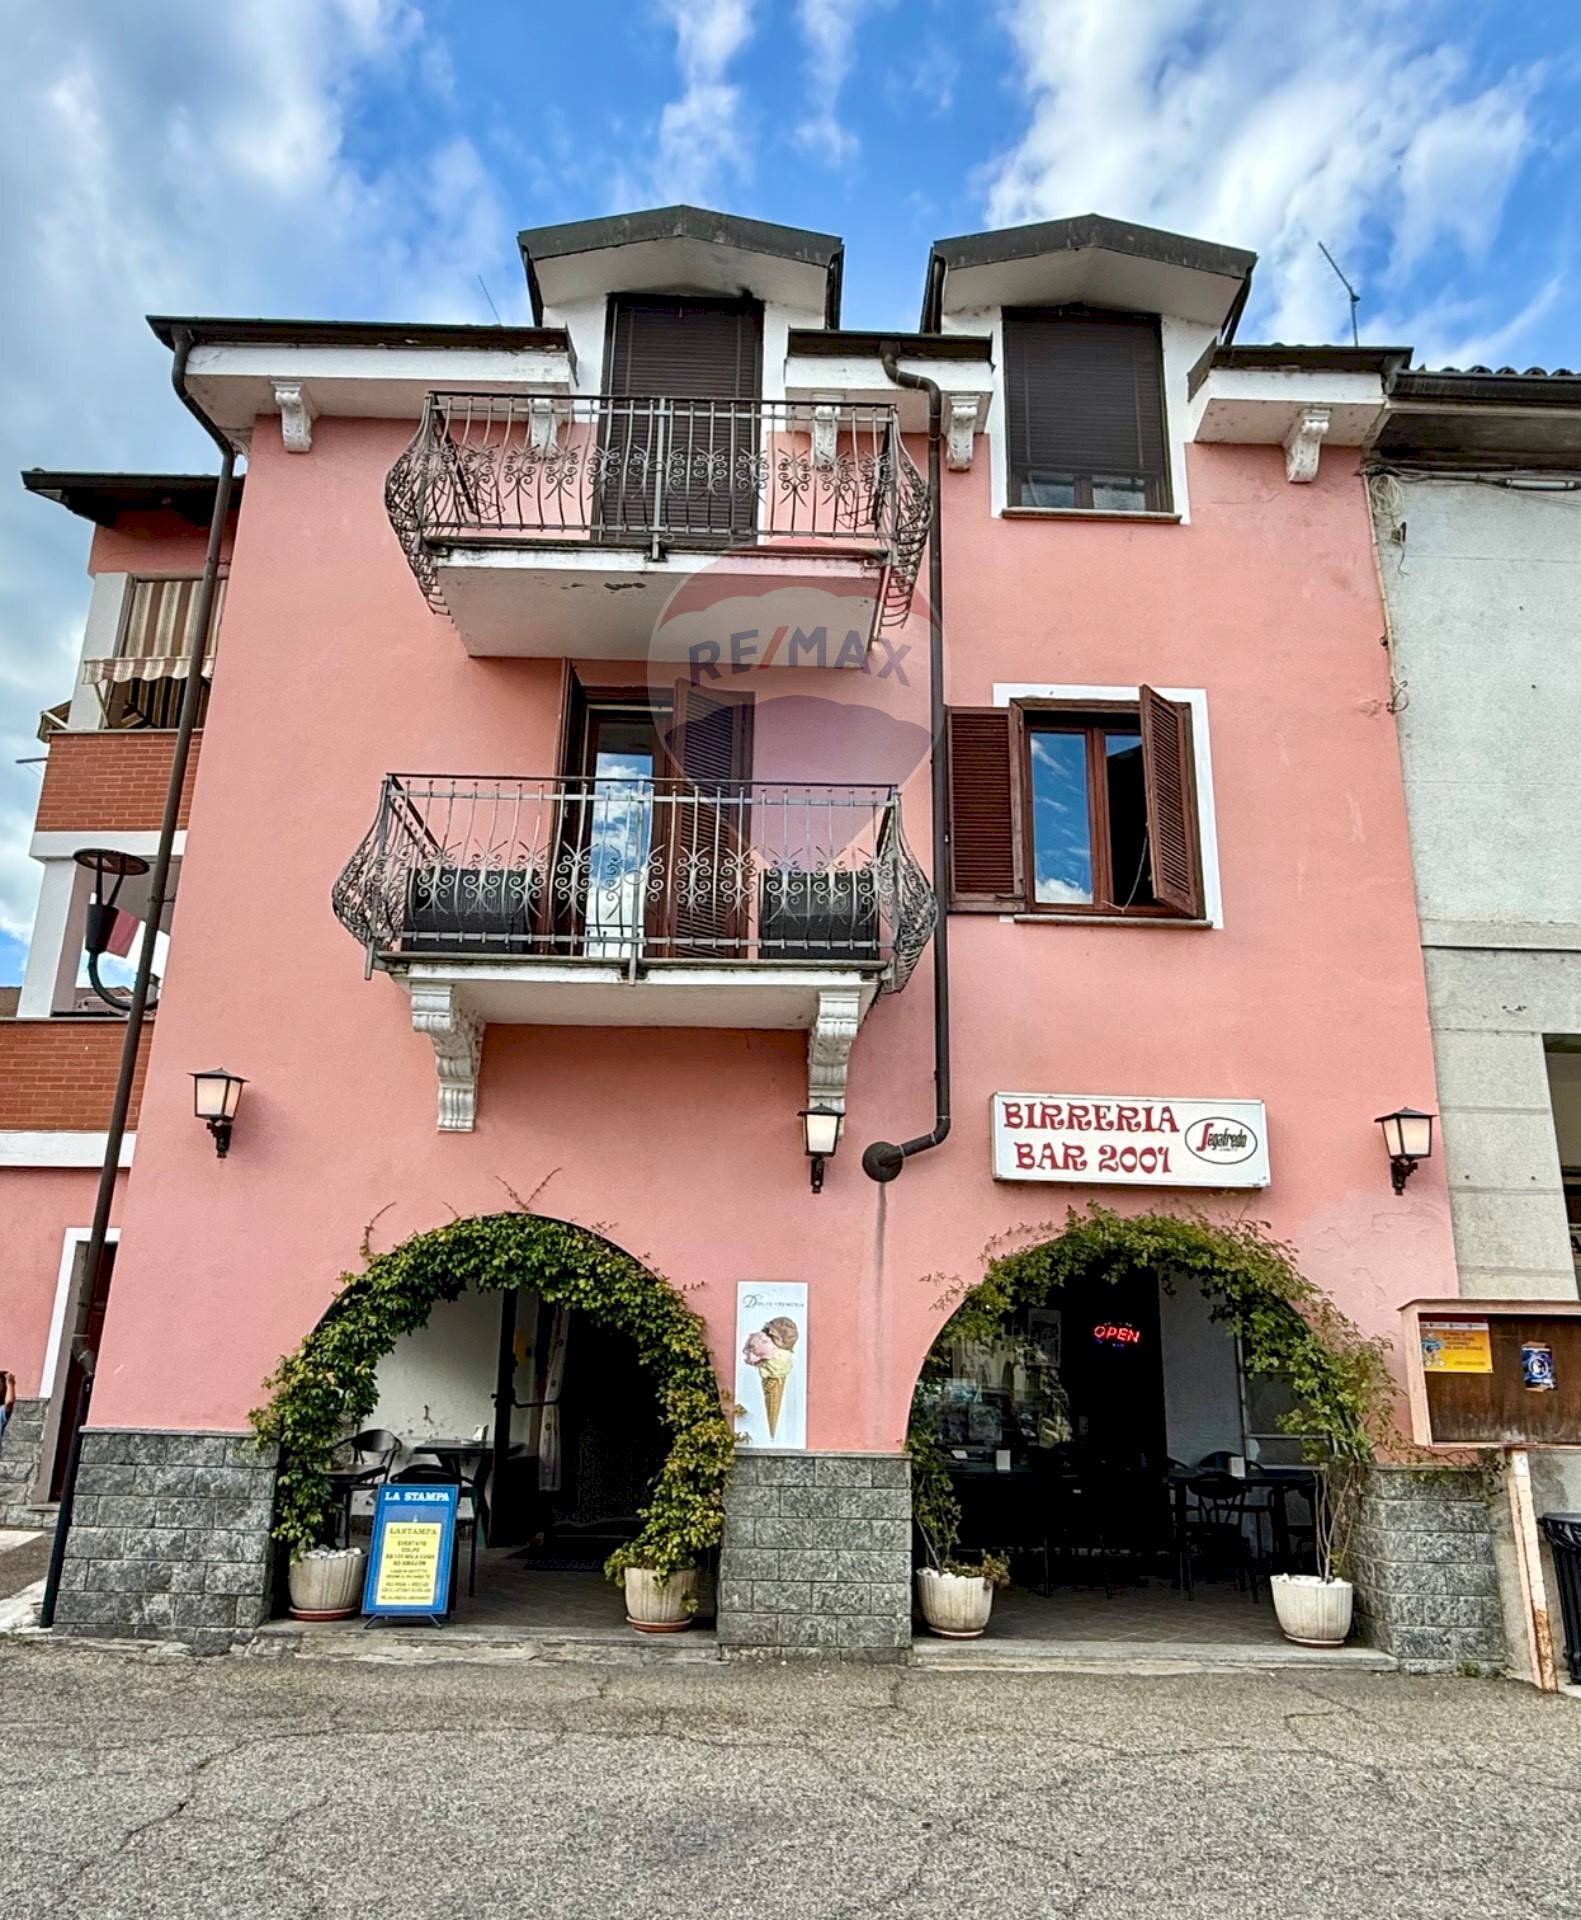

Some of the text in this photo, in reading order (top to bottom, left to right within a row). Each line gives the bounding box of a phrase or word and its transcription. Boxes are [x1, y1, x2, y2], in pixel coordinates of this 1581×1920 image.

[1002, 1101, 1180, 1133] BIRRERIA
[1195, 1122, 1248, 1152] Segafredo
[1014, 1141, 1173, 1174] BAR 2001
[1094, 1325, 1140, 1344] OPEN
[384, 1491, 450, 1502] LA STAMPA
